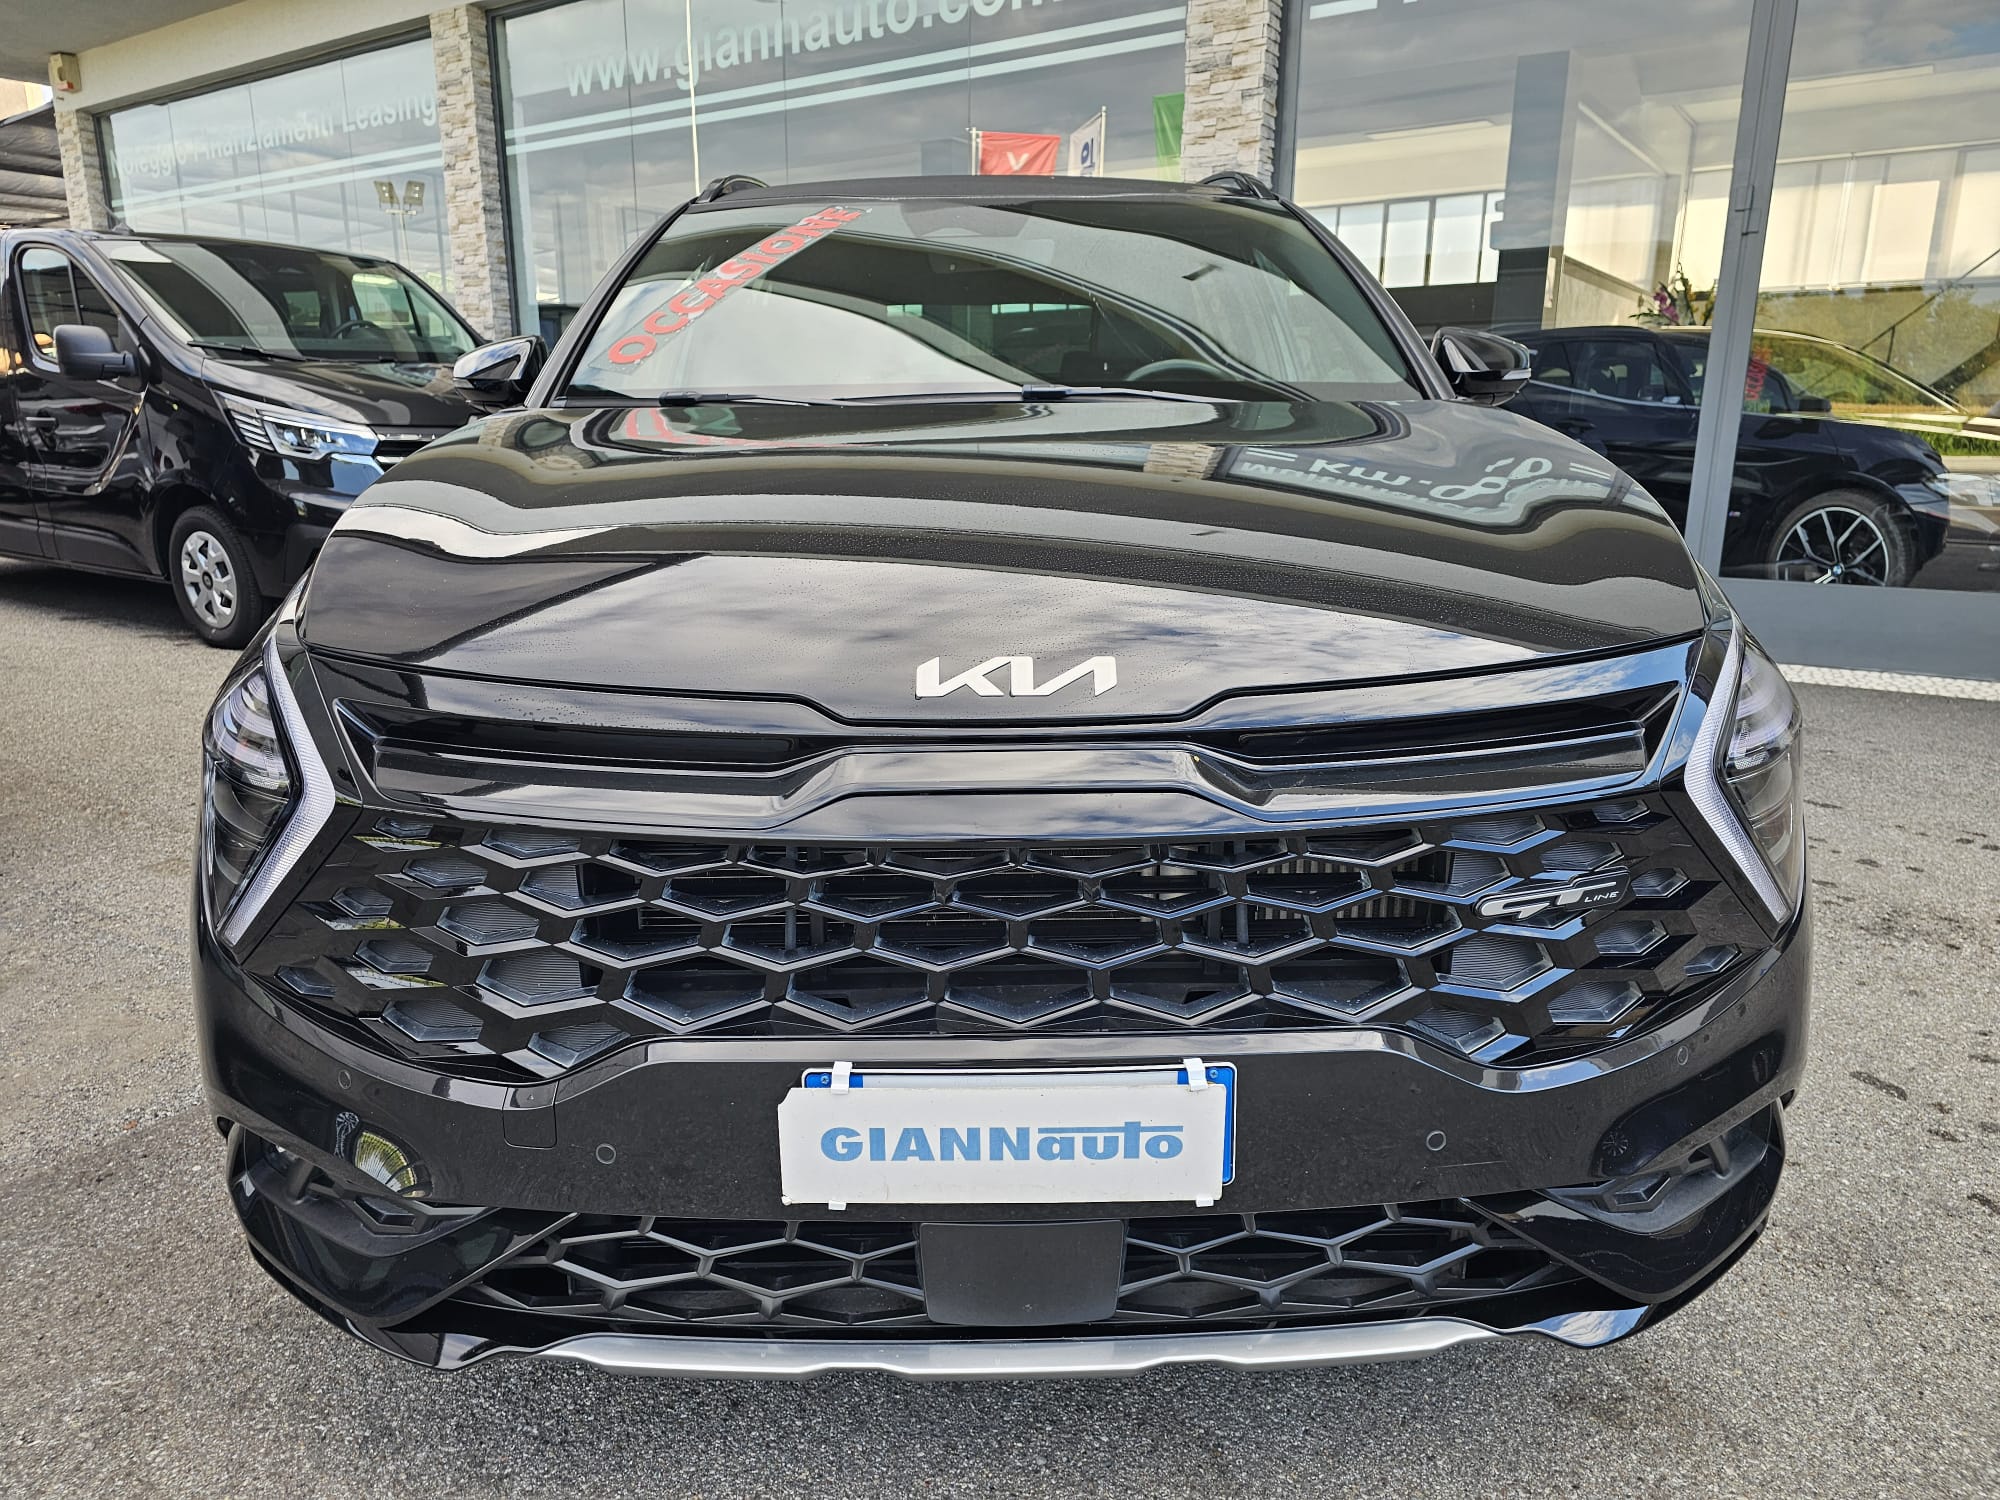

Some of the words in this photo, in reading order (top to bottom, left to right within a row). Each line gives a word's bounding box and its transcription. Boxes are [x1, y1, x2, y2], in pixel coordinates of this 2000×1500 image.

[567, 0, 1064, 97] www.giannauto.c
[343, 93, 437, 132] Leasing
[608, 206, 861, 364] OCCASIONE
[916, 656, 1117, 697] KIA
[1481, 882, 1616, 919] GT
[1584, 891, 1619, 903] LINE
[820, 1121, 1183, 1162] GIANNauto
